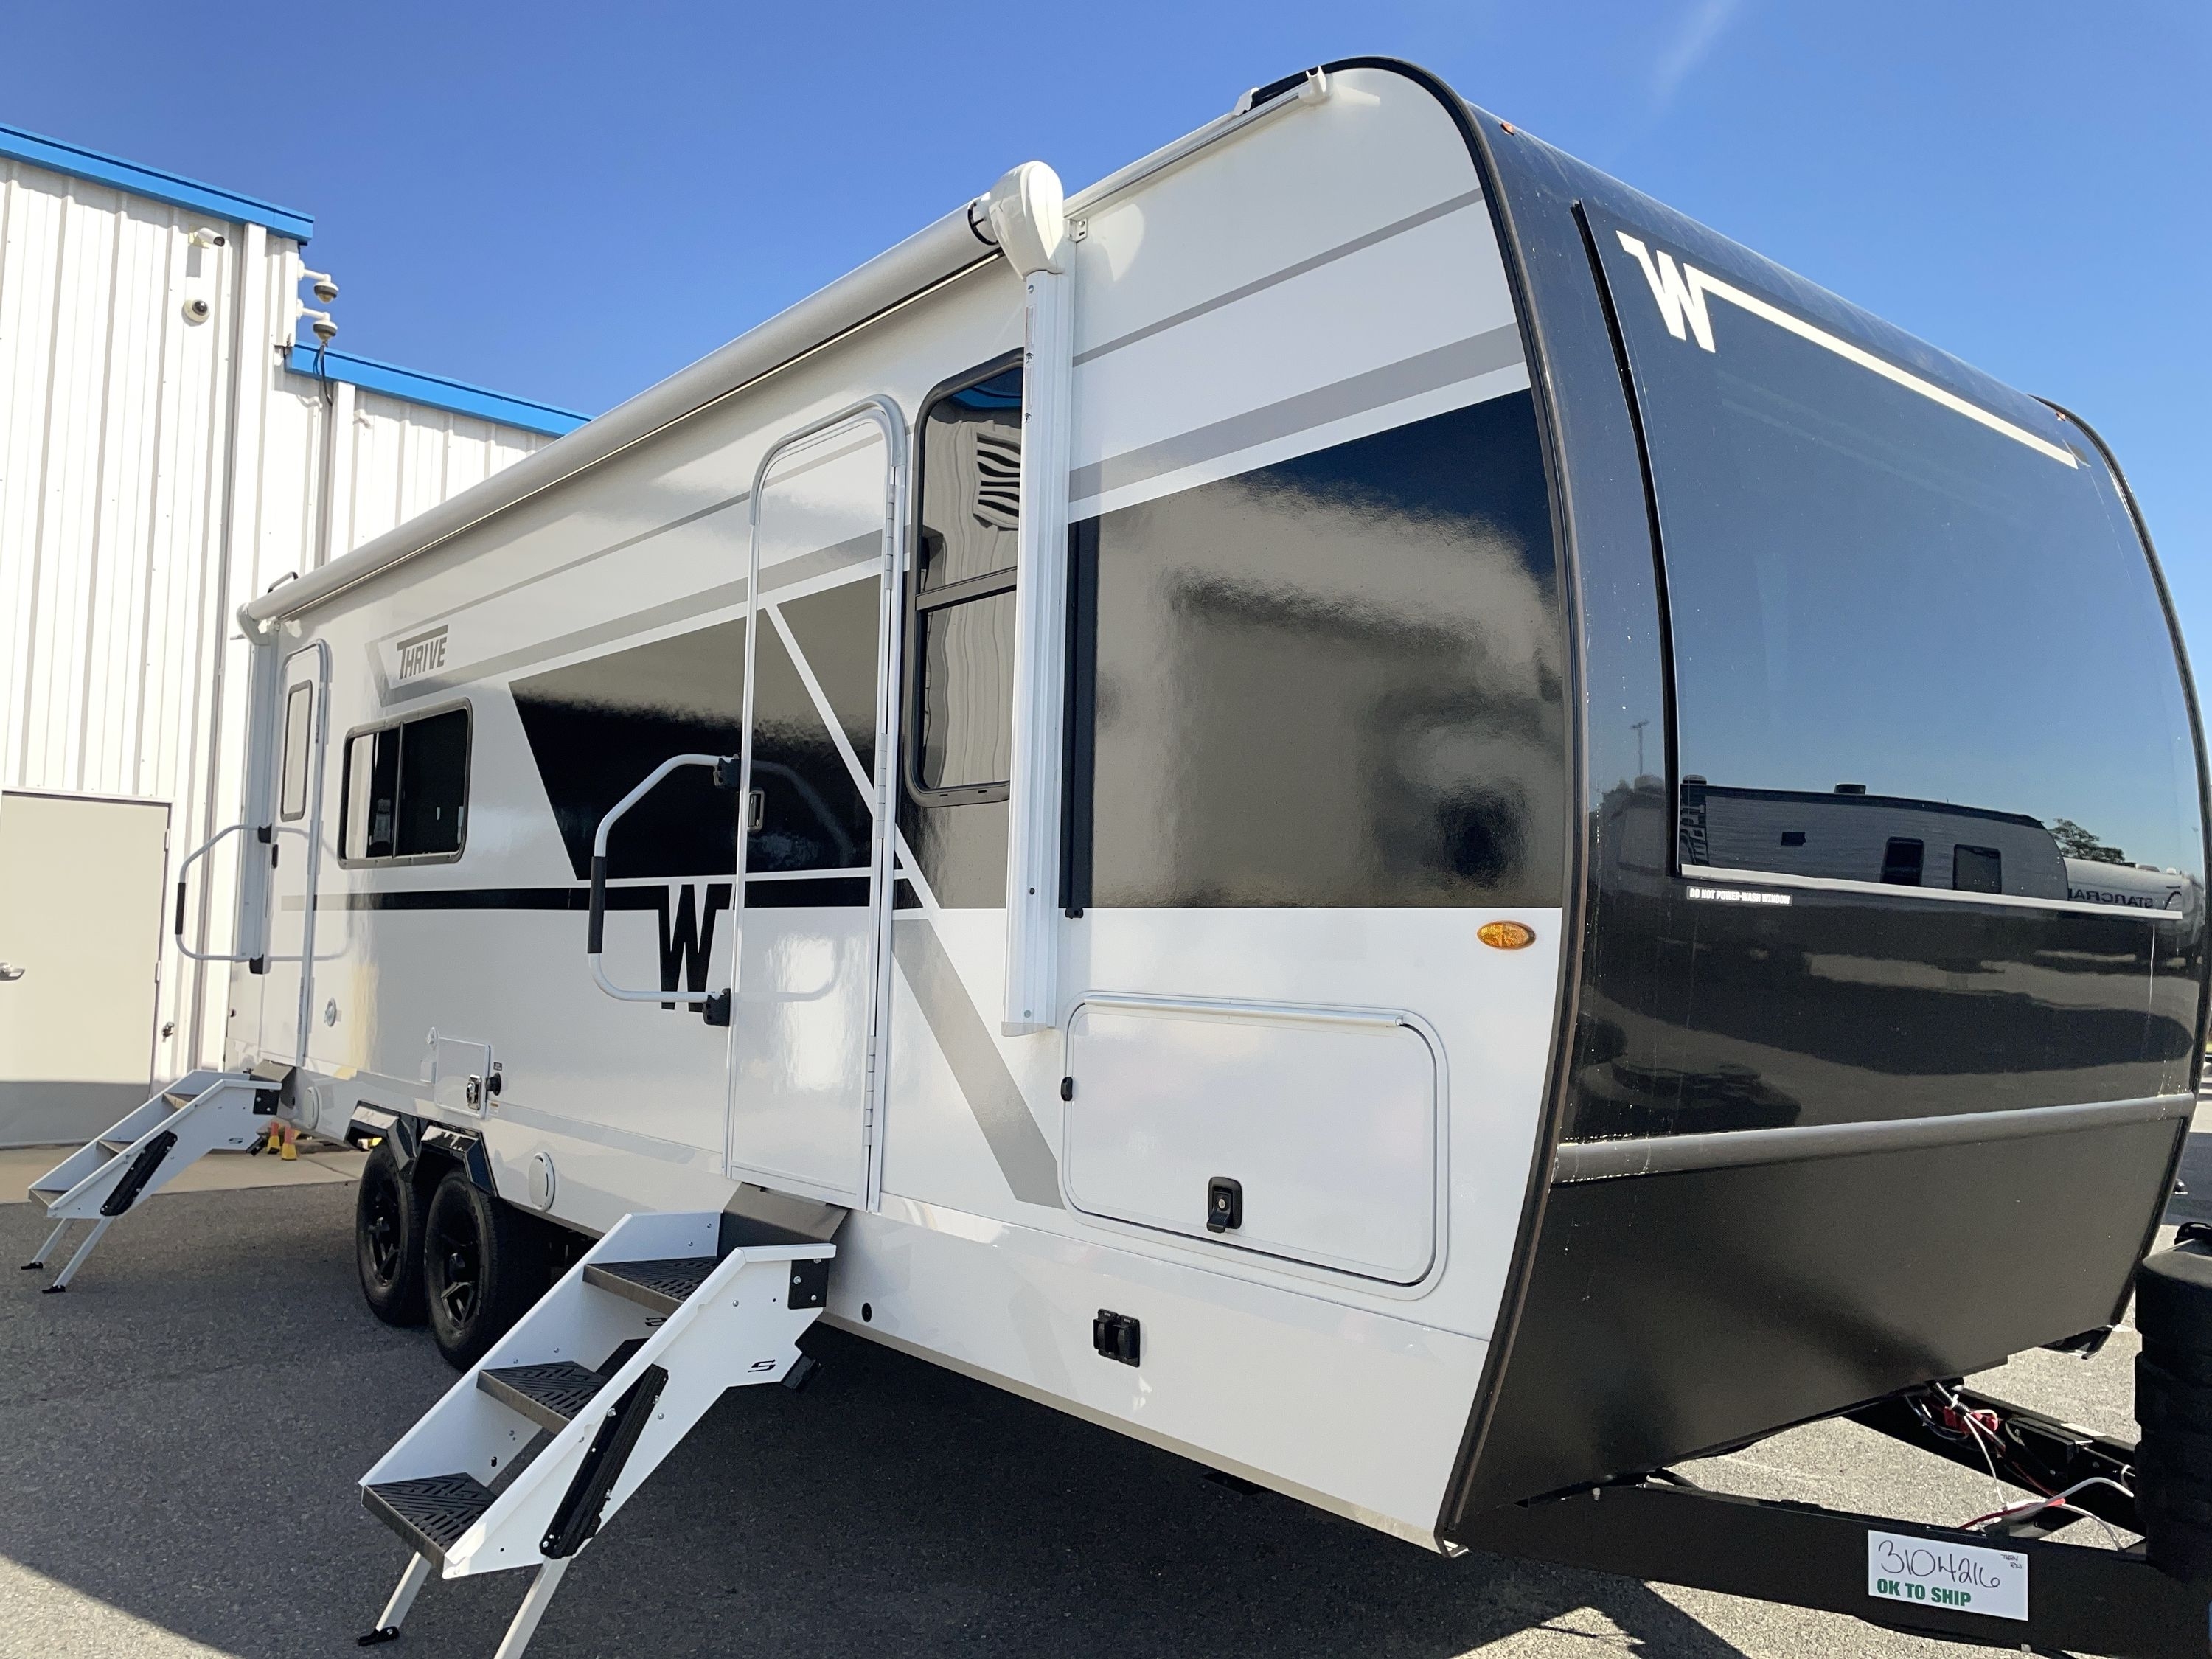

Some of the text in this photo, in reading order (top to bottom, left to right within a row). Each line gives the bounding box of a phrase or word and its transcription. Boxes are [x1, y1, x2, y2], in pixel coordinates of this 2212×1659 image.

[397, 624, 449, 680] THRIVE
[1689, 888, 1790, 905] DO NOT POWER-WASH WINDOW
[1878, 1540, 2000, 1588] 3104216
[1877, 1578, 1972, 1607] OK TO SHIP
